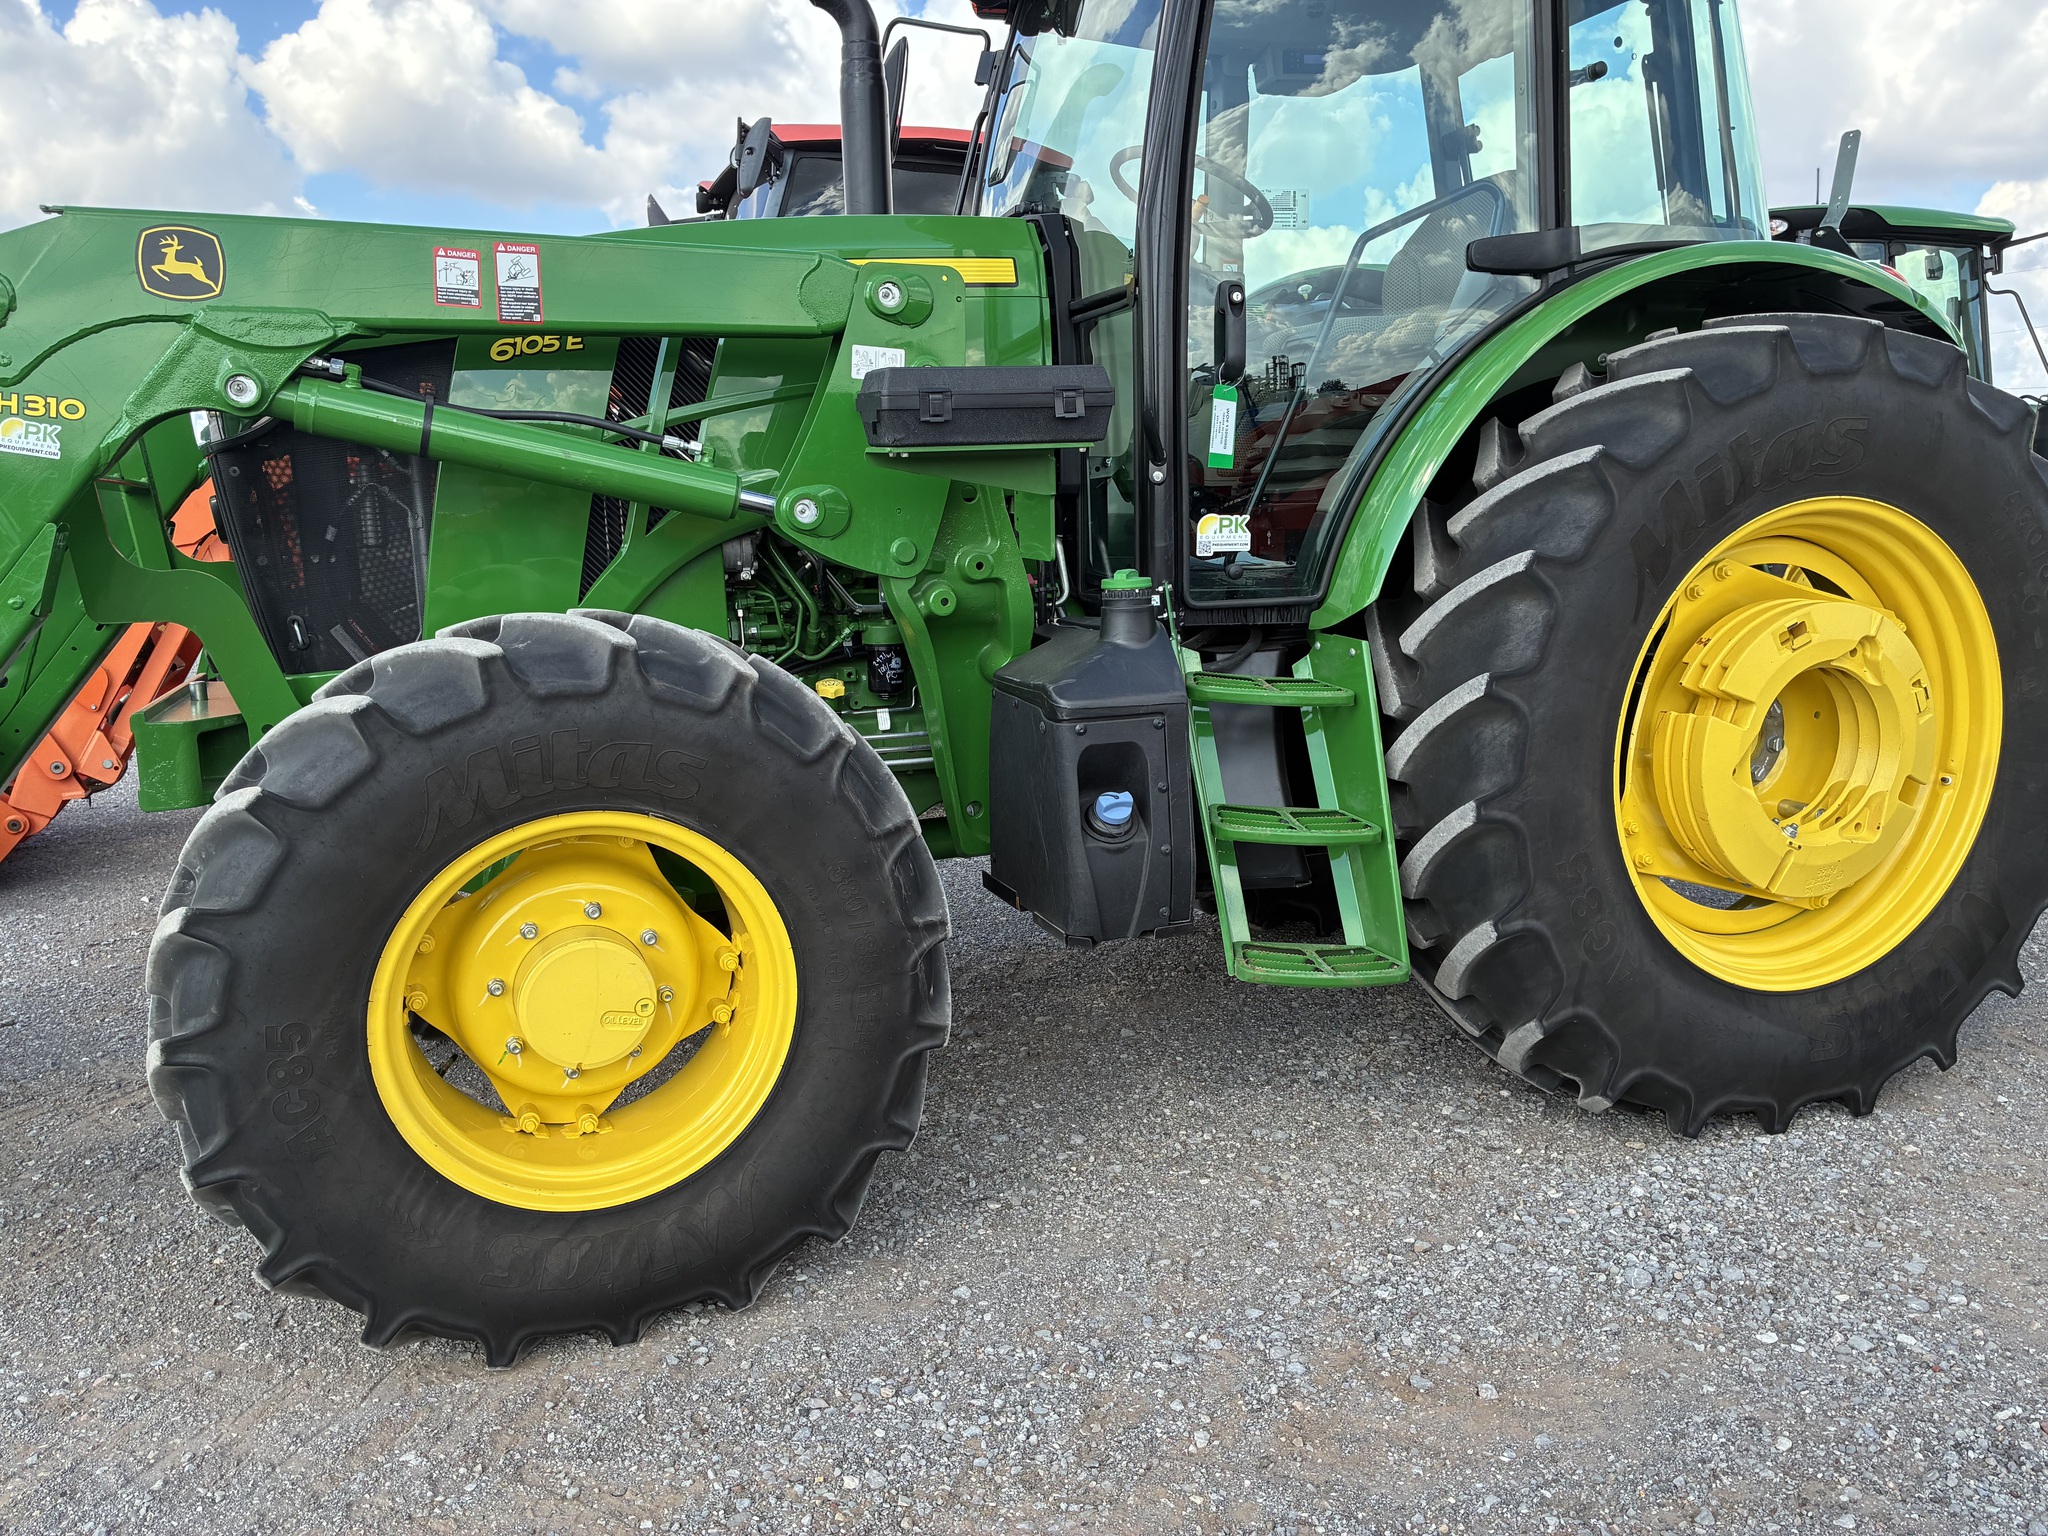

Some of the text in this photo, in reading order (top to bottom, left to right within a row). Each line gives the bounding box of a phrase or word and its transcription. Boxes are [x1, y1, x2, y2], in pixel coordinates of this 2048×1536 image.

[447, 250, 477, 259] DANGER
[507, 245, 536, 253] DANGER
[489, 335, 584, 362] 6105 E
[1, 437, 58, 450] EQUIPMENT
[1629, 415, 1870, 624] Mitas
[415, 728, 708, 852] Mitas
[603, 1015, 642, 1026] OIL LEVEL
[264, 1022, 337, 1154] AC85
[479, 1162, 757, 1294] Mitas
